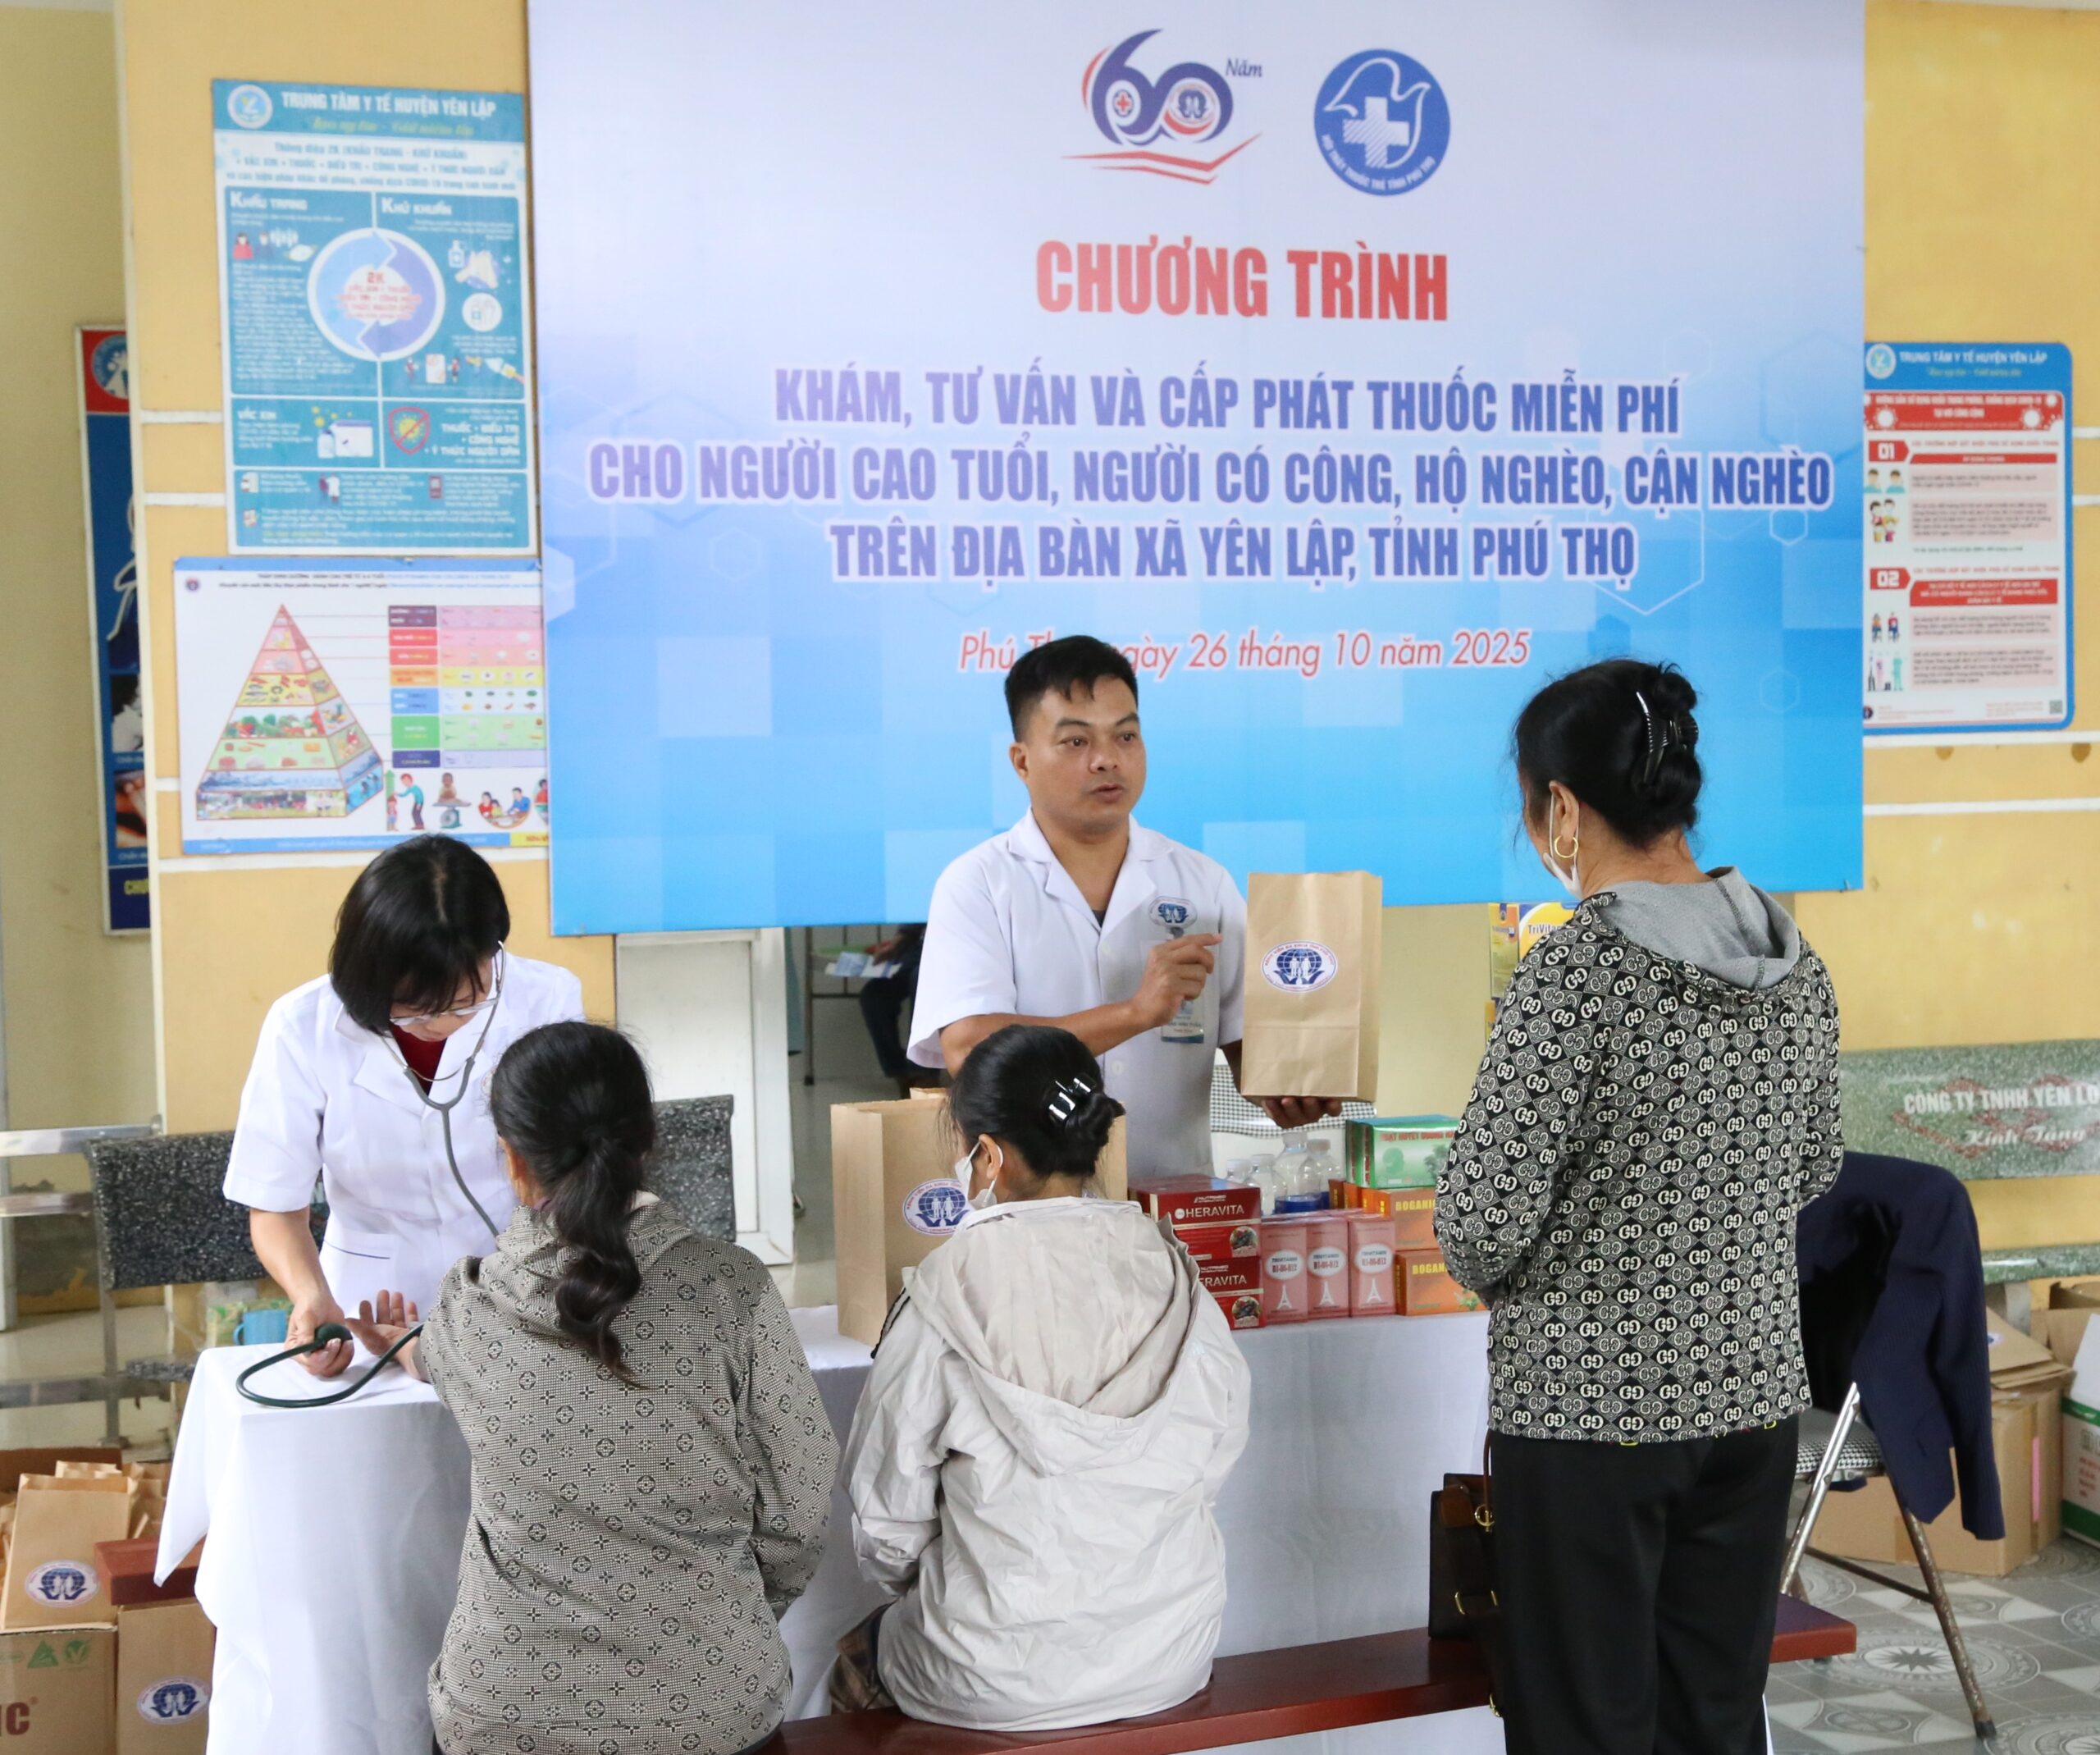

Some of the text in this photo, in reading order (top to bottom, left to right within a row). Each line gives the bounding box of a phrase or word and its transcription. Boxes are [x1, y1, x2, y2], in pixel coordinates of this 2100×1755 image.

[1226, 58, 1263, 78] Năm
[281, 91, 496, 120] TRUNG TÂM Y TẾ HUYỆN YÊN LẬP
[1036, 235, 1448, 321] CHƯƠNG TRÌNH
[1899, 350, 1930, 363] TRUNG
[775, 357, 1681, 434] KHÁM, TƯ VẤN VÀ CẤP PHÁT THUỐC MIỄN PHÍ
[1878, 442, 1896, 459] 01
[590, 443, 683, 499] CHO
[700, 438, 838, 500] NGƯỜI
[852, 447, 937, 501] CAO
[951, 432, 1060, 506] TUỔI,
[1074, 443, 1200, 503] NGƯỜI
[1217, 446, 1269, 503] CÓ
[1285, 446, 1401, 509] CÔNG,
[1415, 447, 1467, 513] HỘ
[1482, 450, 1612, 509] NGHÈO,
[1626, 449, 1698, 514] CẬN
[1712, 451, 1831, 505] NGHÈO
[830, 514, 1634, 587] TRÊN ĐỊA BÀN XÃ YÊN LẬP, TỈNH PHÚ THỌ
[1877, 570, 1900, 588] 02
[960, 630, 1531, 679] Phú gày 26 tháng 10 năm 2025
[1955, 1090, 1974, 1113] TY
[1979, 1088, 2029, 1111] TNHH
[1185, 1204, 1245, 1218] HERAVITA
